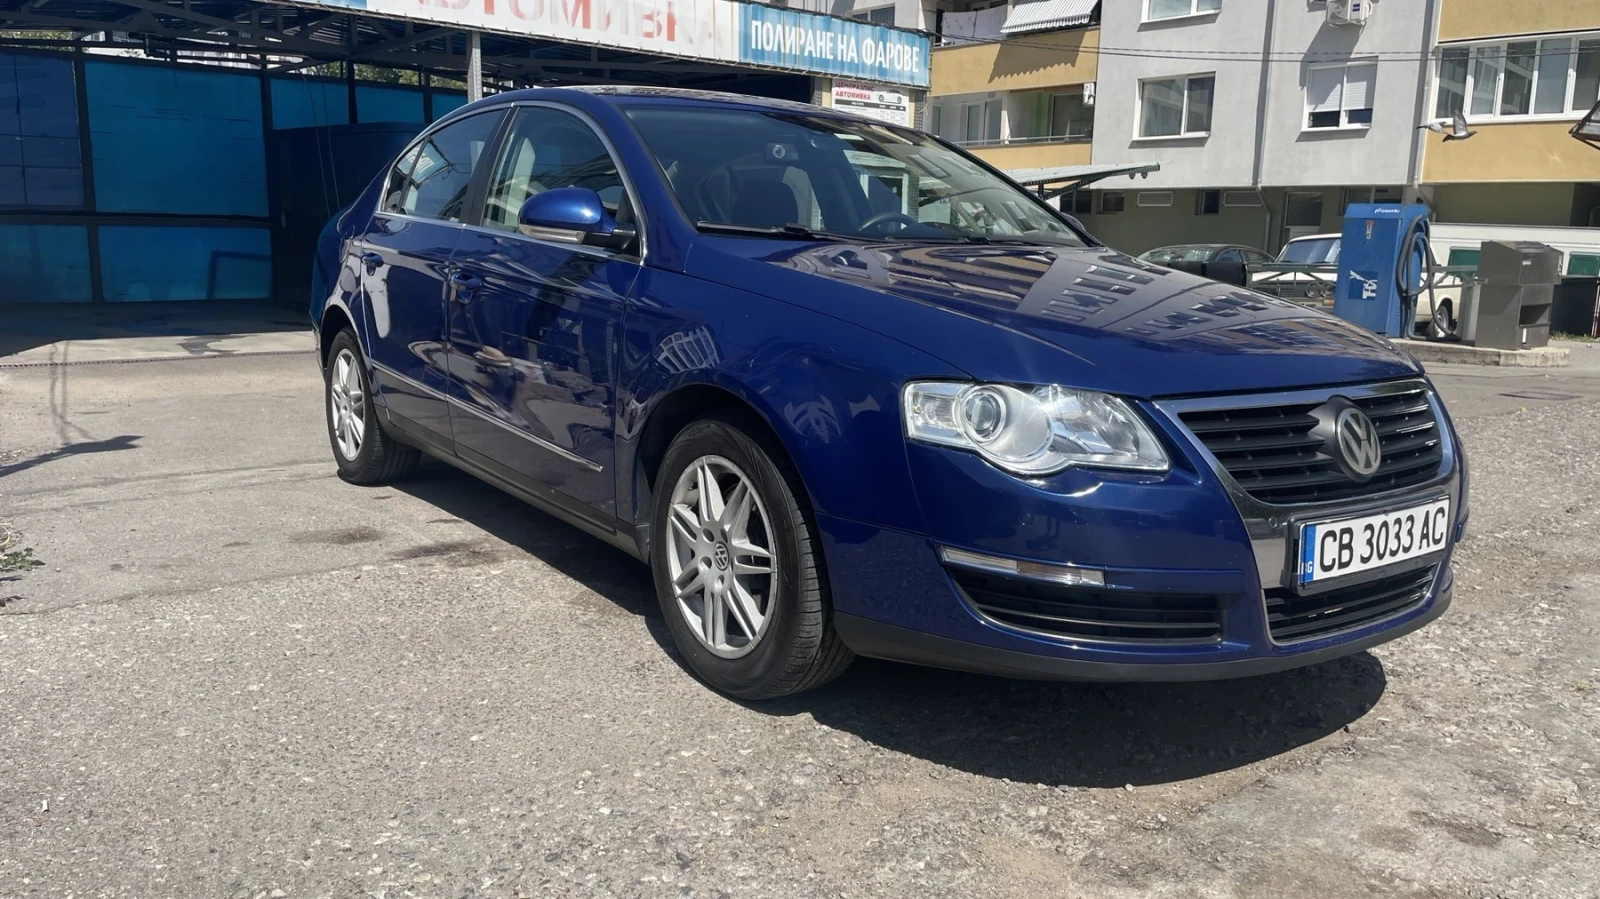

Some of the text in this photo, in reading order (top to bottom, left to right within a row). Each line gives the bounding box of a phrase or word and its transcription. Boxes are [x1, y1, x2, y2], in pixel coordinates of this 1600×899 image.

[751, 20, 919, 73] ПОЛИРАНЕ НА ФАРОВЕ
[835, 82, 875, 91] ЦЕНОРАЗПИС
[835, 90, 871, 101] АВТОМИВКА
[1319, 506, 1446, 573] CB 3033 AC
